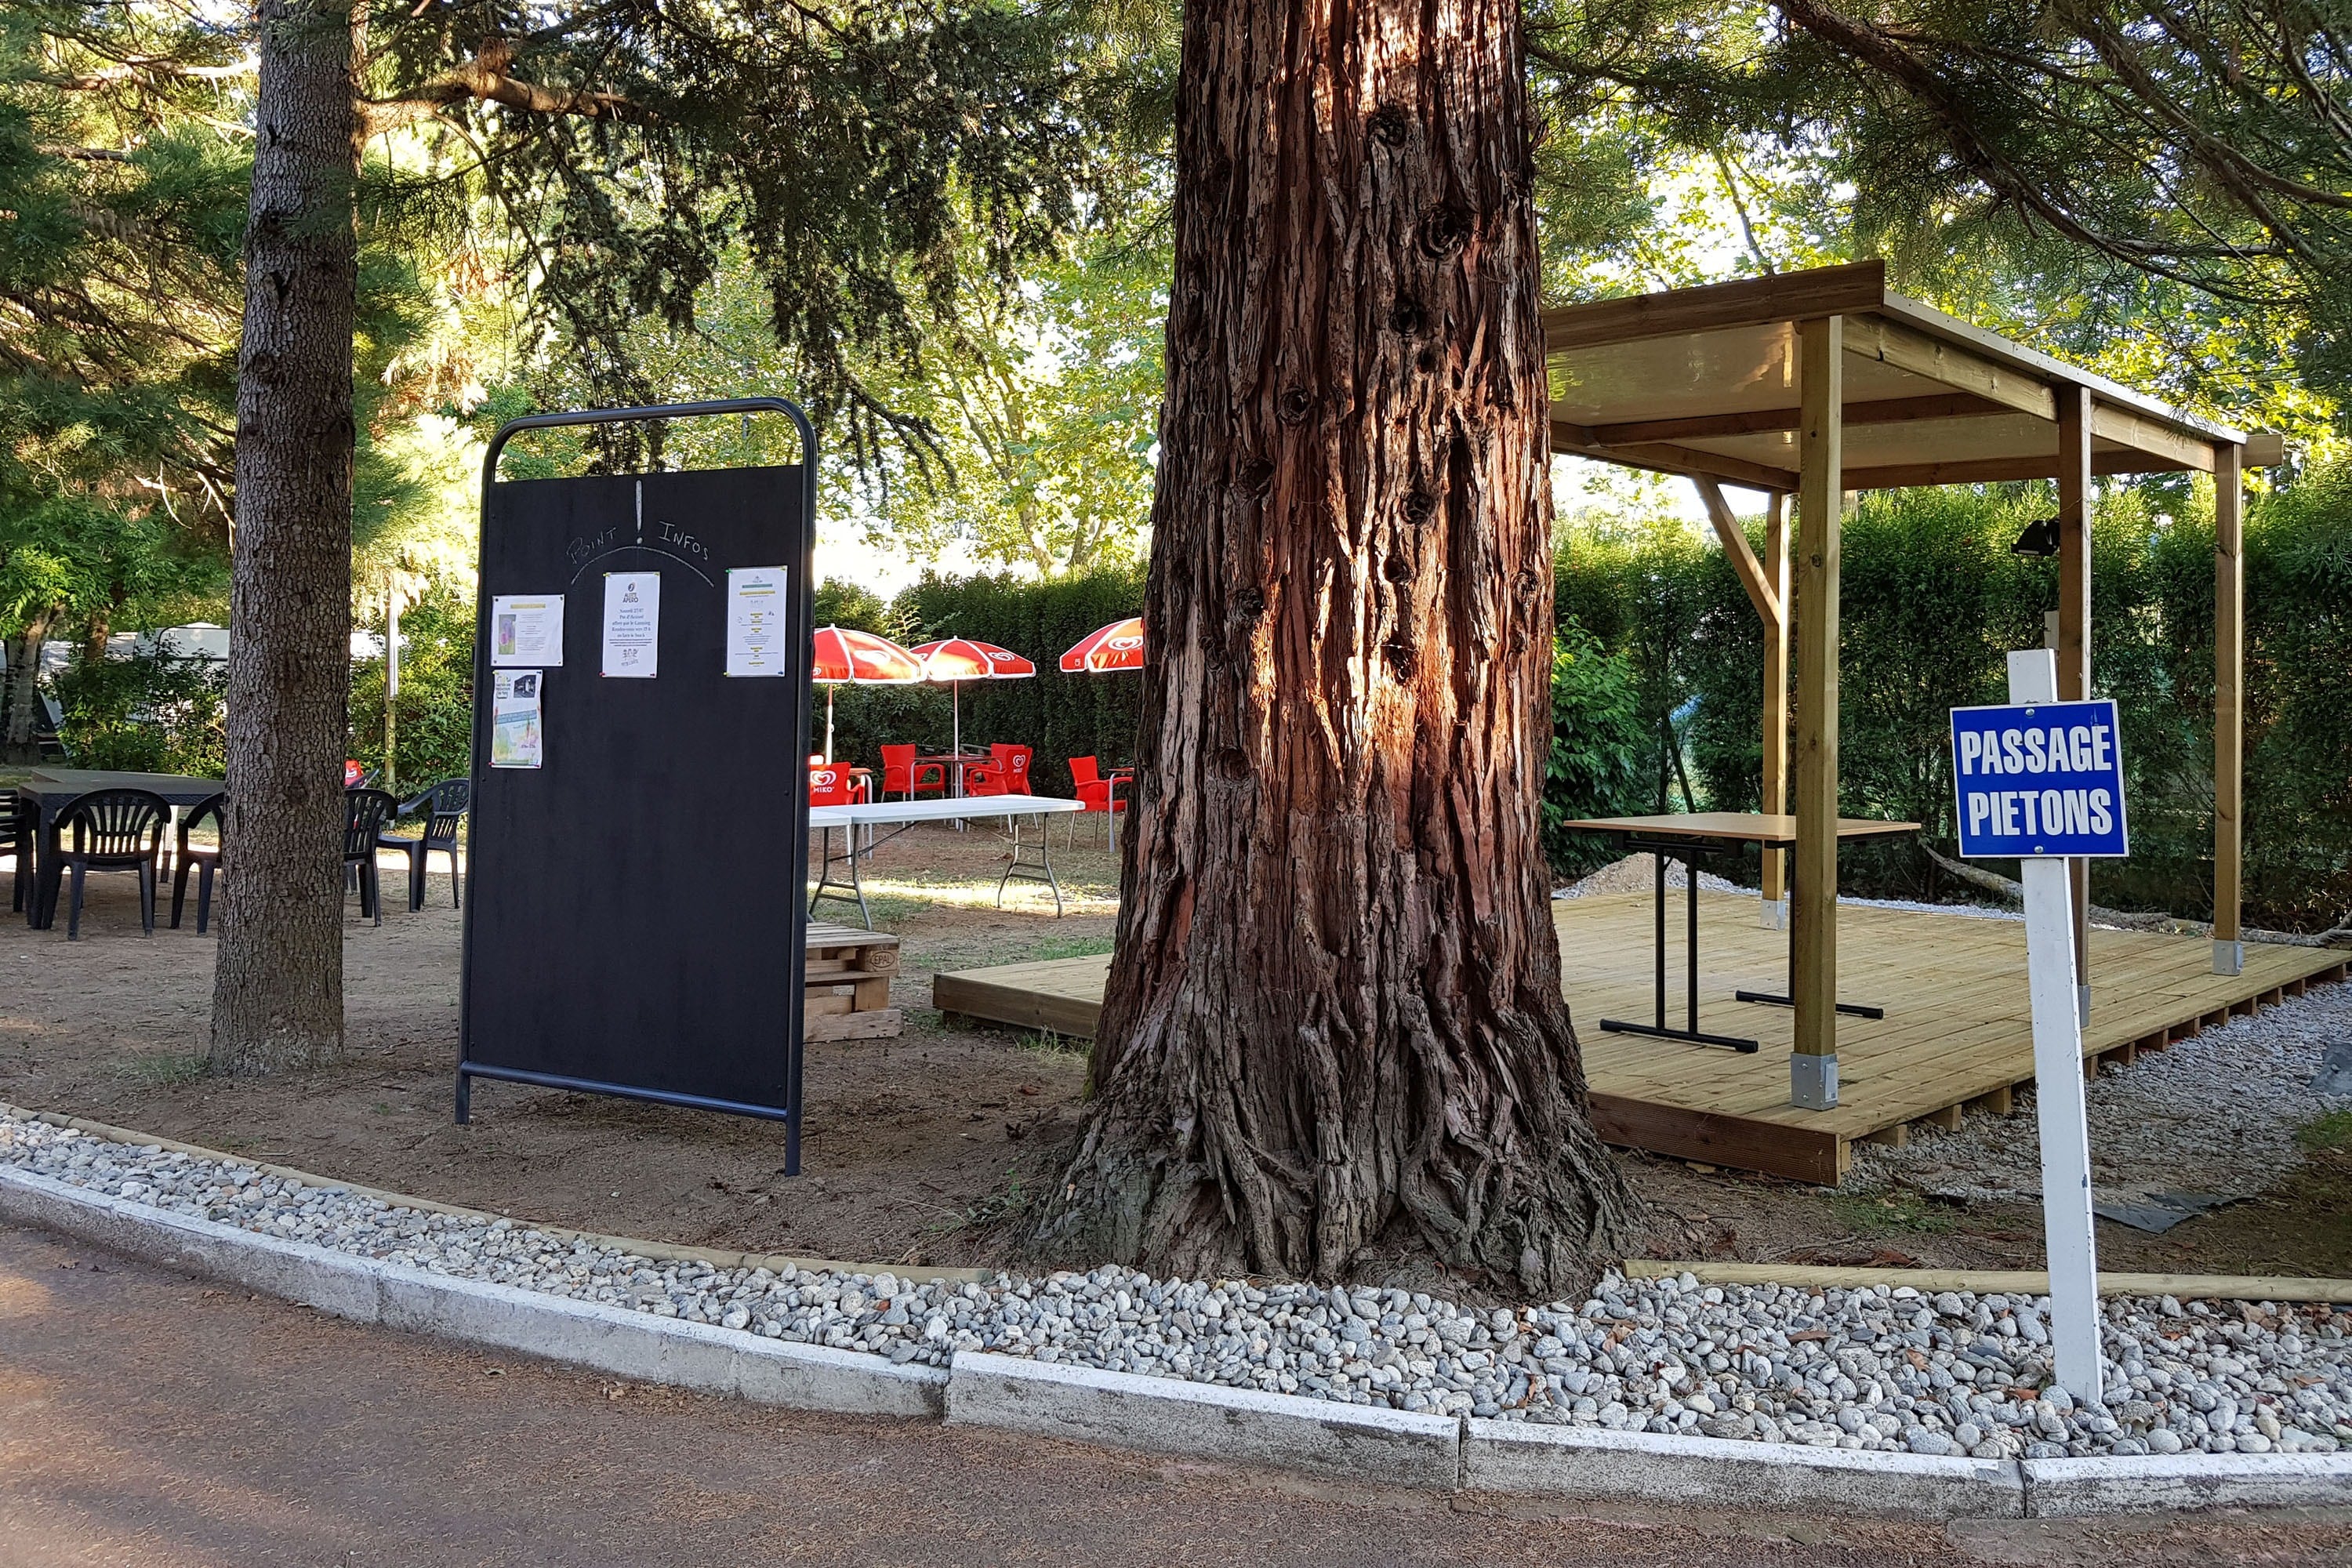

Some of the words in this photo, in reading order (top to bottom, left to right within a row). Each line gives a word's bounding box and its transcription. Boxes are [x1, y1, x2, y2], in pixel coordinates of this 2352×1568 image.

[566, 527, 617, 564] POINT
[659, 521, 709, 561] INFOS
[1960, 725, 2112, 775] PASSAGE
[1968, 788, 2113, 836] PIETONS
